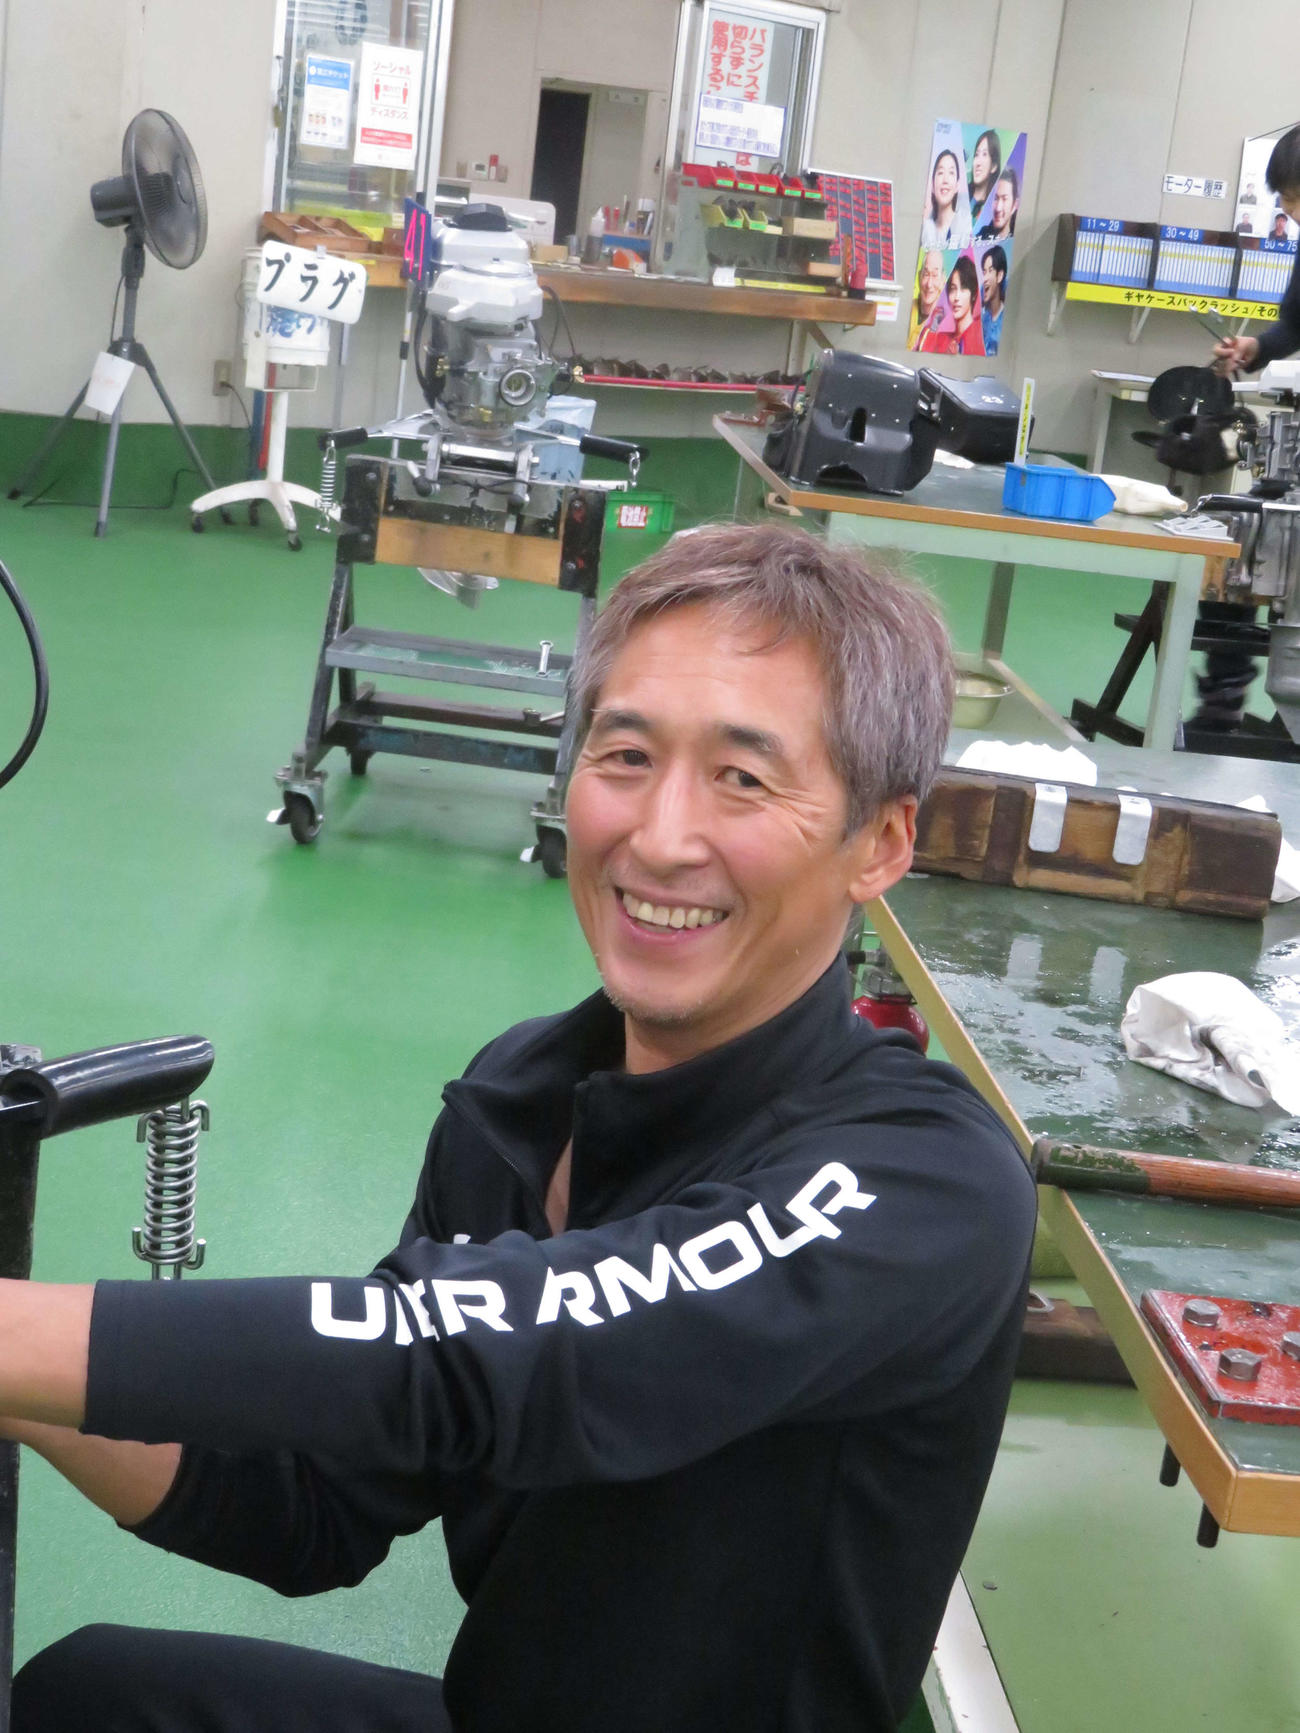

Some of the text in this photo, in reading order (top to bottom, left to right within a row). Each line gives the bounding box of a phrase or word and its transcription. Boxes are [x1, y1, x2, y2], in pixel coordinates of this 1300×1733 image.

[373, 61, 412, 76] ソーシャル
[726, 23, 749, 87] 切らずに
[370, 106, 409, 121] ディスタンス
[1165, 175, 1224, 199] モーター履歴
[404, 209, 426, 281] 41
[264, 252, 356, 310] プラグ
[1124, 291, 1280, 319] ギヤケースバックラッシュ/その
